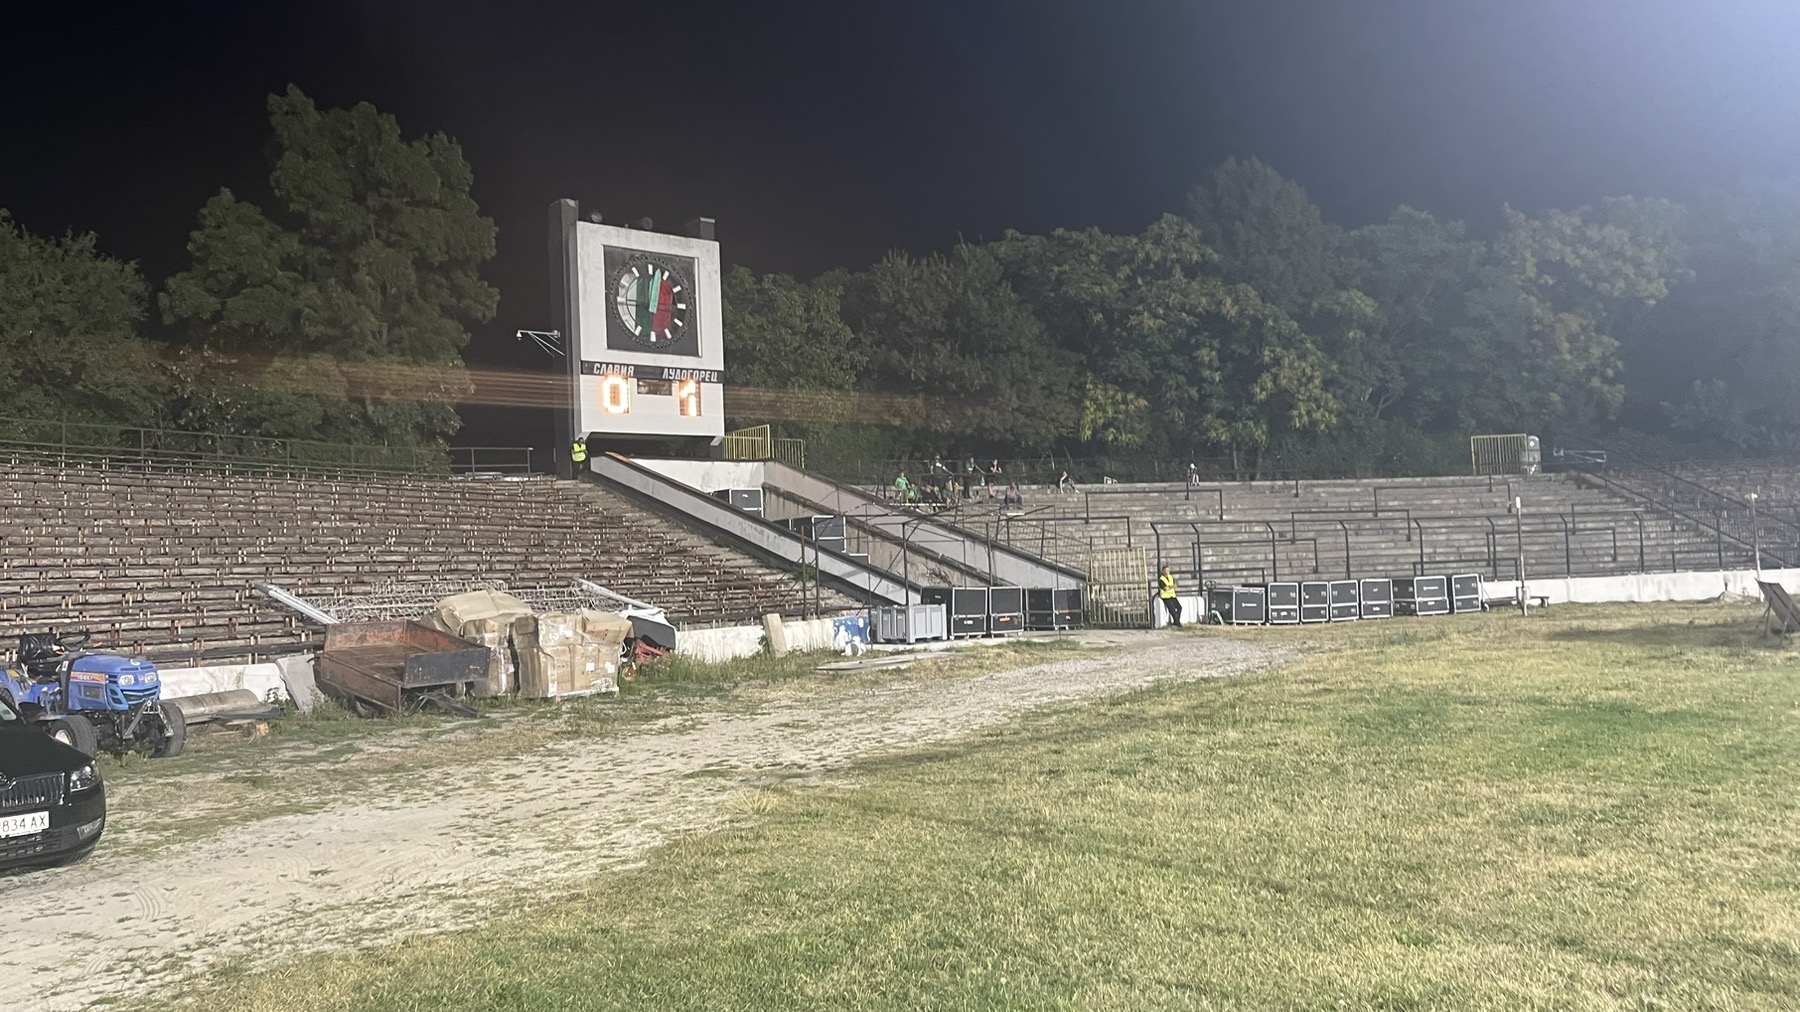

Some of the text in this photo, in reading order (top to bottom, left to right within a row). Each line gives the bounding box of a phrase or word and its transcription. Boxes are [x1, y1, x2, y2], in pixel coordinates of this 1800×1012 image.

[593, 363, 635, 377] СЛАВИЯ
[662, 368, 718, 382] ЛУДОГОРЕЦ
[602, 376, 629, 413] 0
[680, 380, 698, 417] 1
[30, 815, 46, 829] AX
